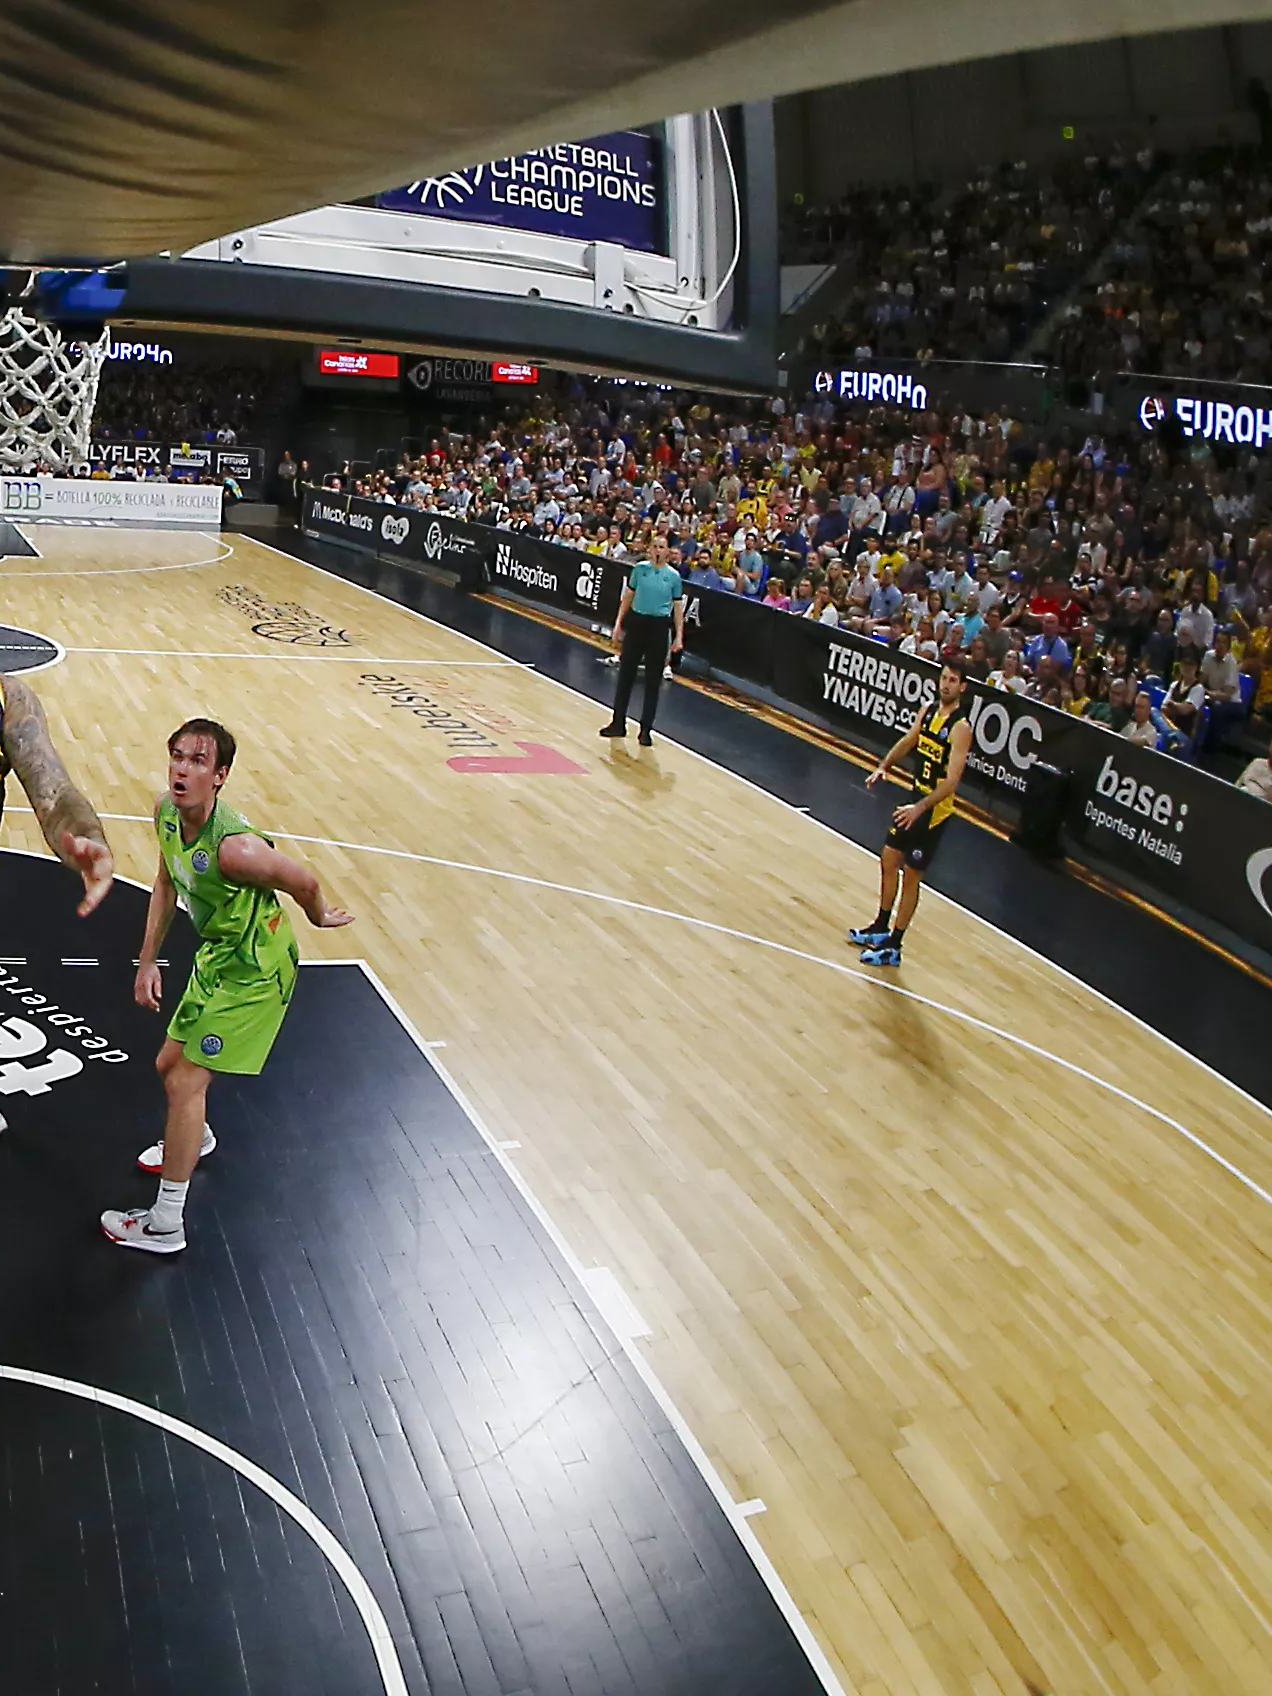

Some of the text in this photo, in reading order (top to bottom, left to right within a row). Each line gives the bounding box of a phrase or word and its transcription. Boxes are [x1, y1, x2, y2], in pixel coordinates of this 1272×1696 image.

[526, 143, 639, 178] KETBALL
[490, 156, 656, 208] CHAMPIONS
[491, 181, 584, 217] LEAGUE
[4, 481, 42, 510] BB
[57, 490, 90, 504] BOTELLA
[93, 492, 123, 506] 100%
[509, 559, 558, 592] Hospiten
[828, 642, 937, 706] TERRENOS
[922, 760, 932, 779] 6
[1084, 800, 1182, 866] Deportes Natalia
